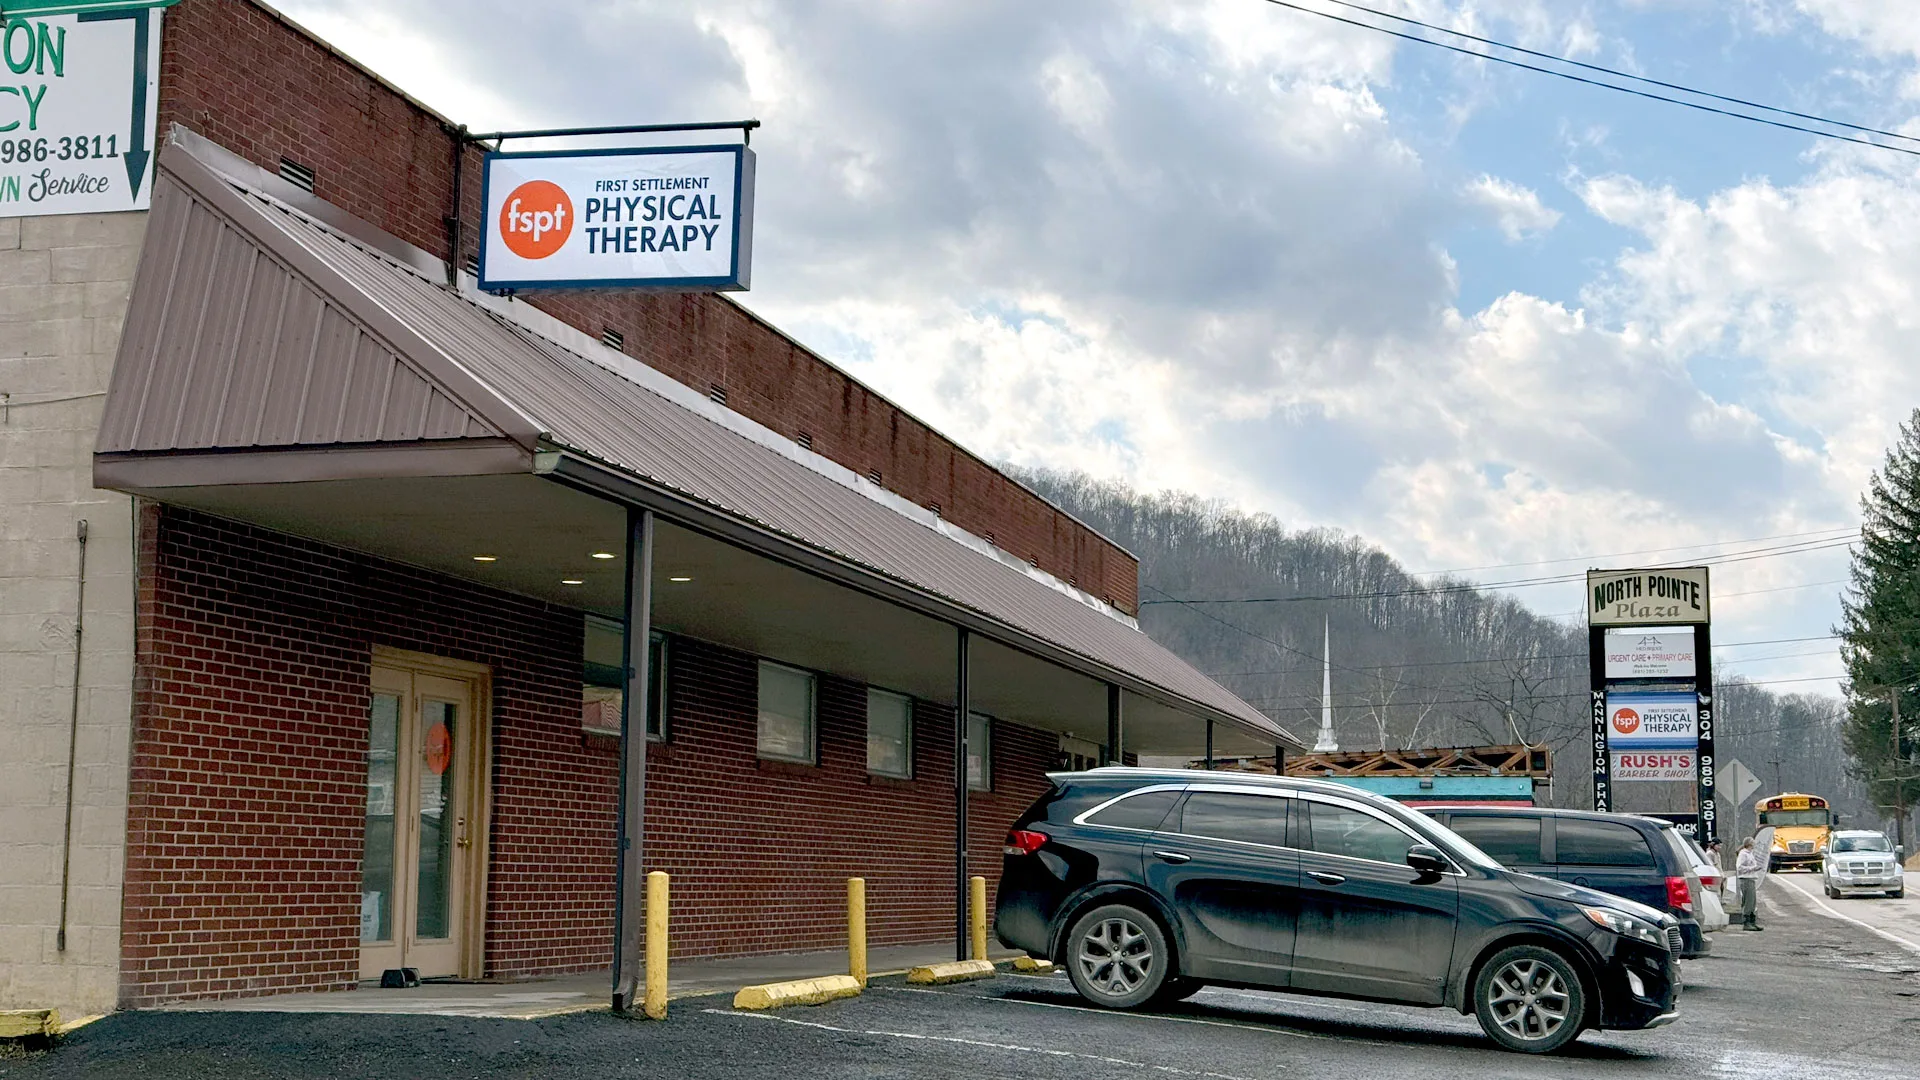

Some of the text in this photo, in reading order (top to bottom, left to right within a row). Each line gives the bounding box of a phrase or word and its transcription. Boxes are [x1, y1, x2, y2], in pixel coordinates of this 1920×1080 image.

[4, 18, 66, 77] ON
[1, 134, 119, 164] 986-3811
[28, 168, 110, 202] Service
[595, 177, 710, 193] FIRST SETTLEMENT
[508, 198, 566, 242] fspt
[585, 194, 722, 223] PHYSICAL
[585, 224, 720, 254] THERAPY
[1594, 575, 1701, 613] NORTH POINTE
[1614, 601, 1681, 619] Plaza
[1607, 652, 1693, 663] URGENT CARE PRIMARY CARE
[1615, 713, 1637, 729] fspt
[1643, 713, 1692, 723] PHYSICAL
[1644, 723, 1692, 733] THERAPY
[1593, 692, 1605, 774] MANNINGTON
[1618, 769, 1691, 778] BARBER SHOP
[1620, 755, 1691, 768] RUSH'S
[1700, 710, 1715, 842] 304 986 3811
